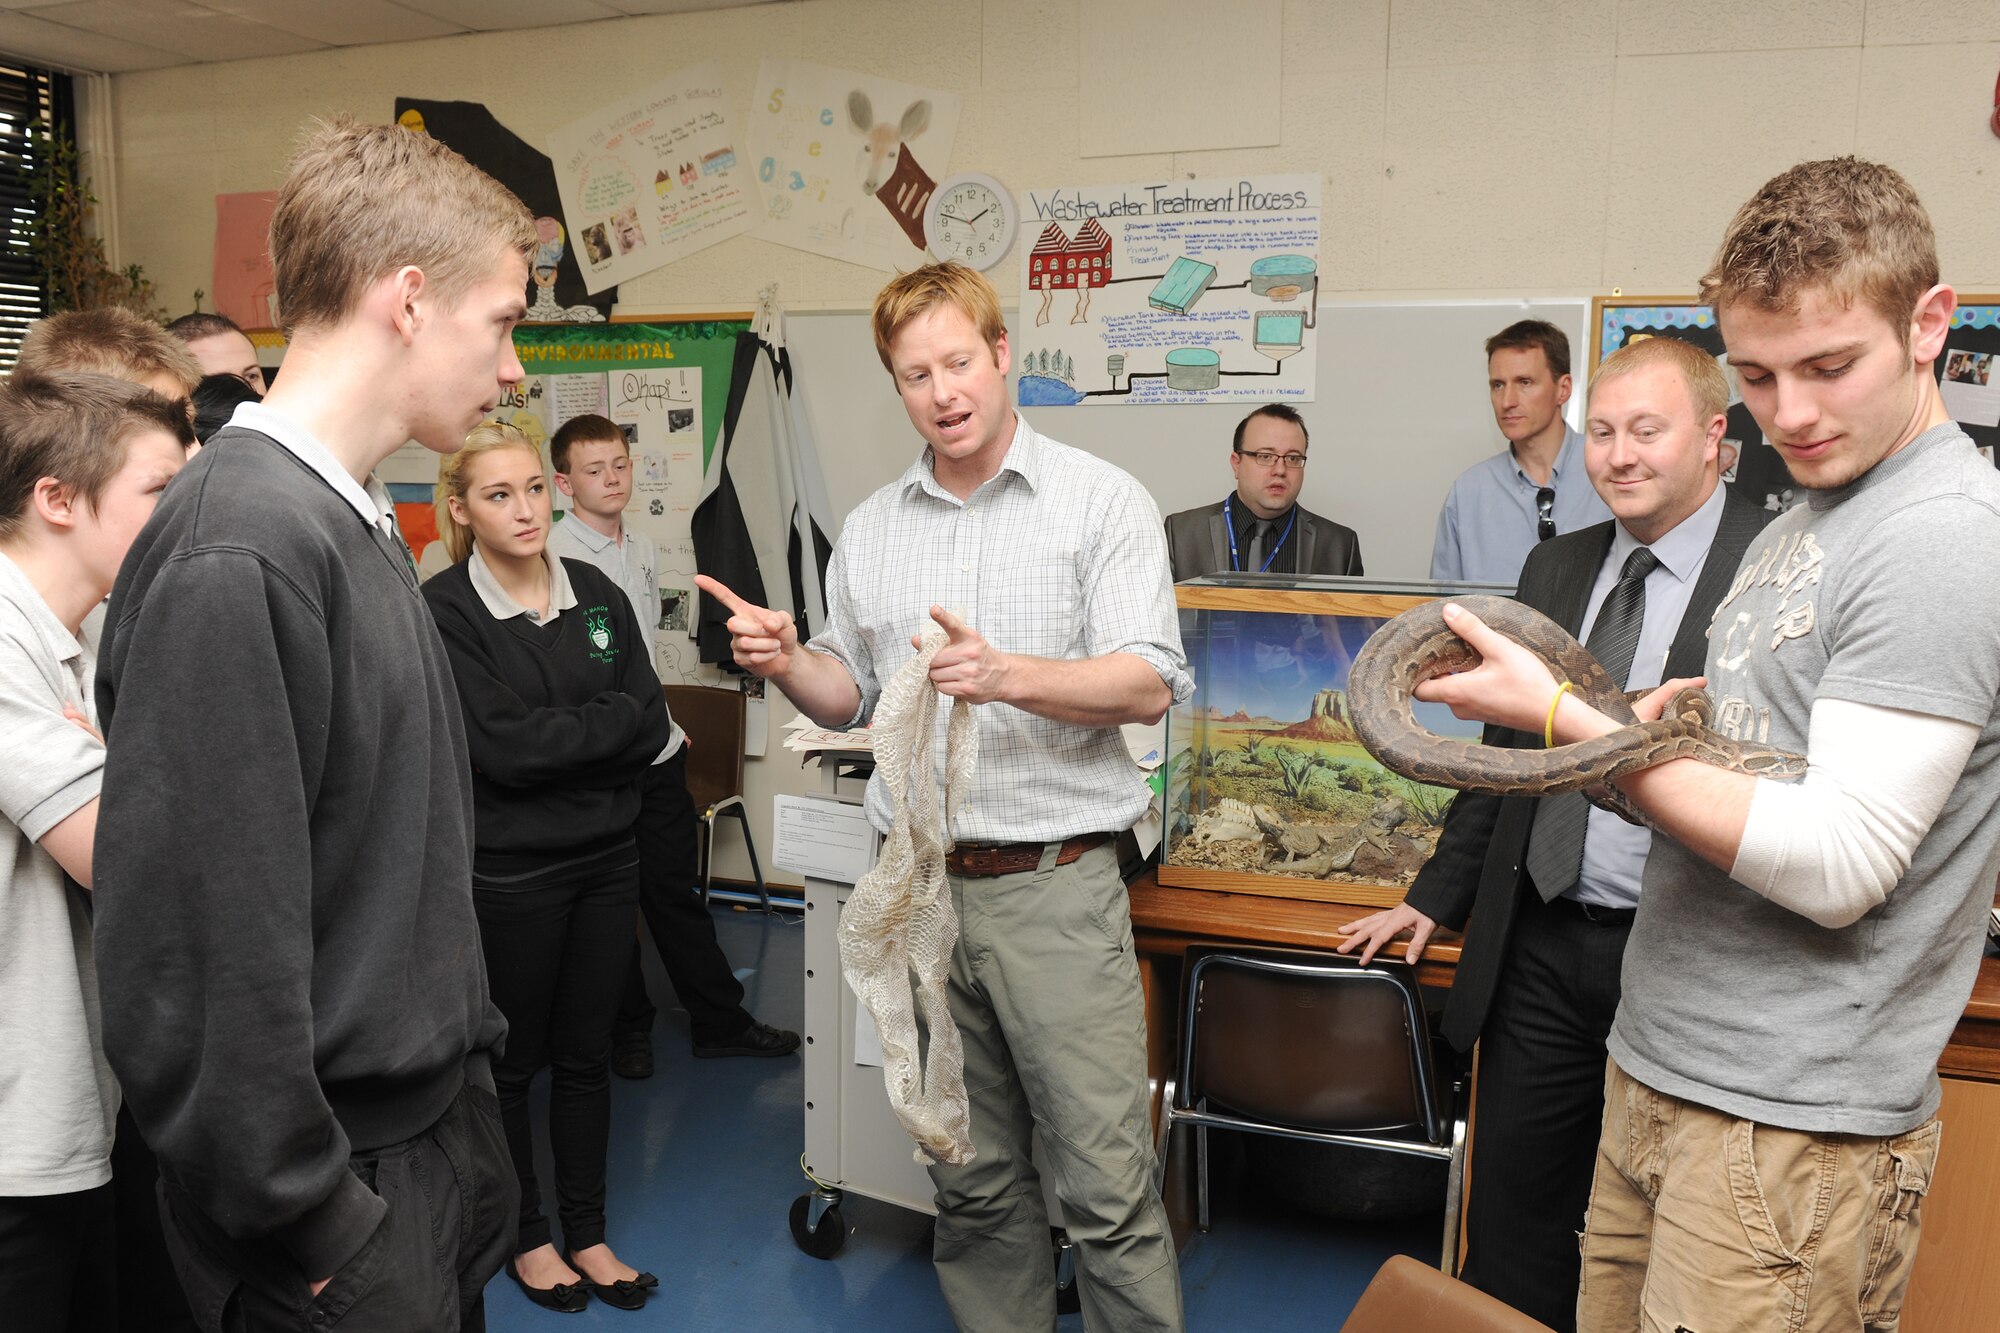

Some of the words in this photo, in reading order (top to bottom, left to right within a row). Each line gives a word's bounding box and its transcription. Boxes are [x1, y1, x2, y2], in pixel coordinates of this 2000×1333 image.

[955, 194, 962, 204] 11
[966, 189, 976, 199] 12
[1030, 189, 1147, 220] Wastewater
[1144, 184, 1233, 213] Treatment
[1239, 181, 1307, 211] Process
[945, 204, 955, 214] 10
[990, 203, 997, 213] 2
[942, 217, 948, 227] 9
[992, 218, 1000, 228] 3
[944, 232, 951, 242] 8
[988, 233, 995, 242] 4
[955, 242, 961, 252] 7
[966, 246, 973, 256] 6
[979, 242, 985, 252] 5
[1127, 246, 1158, 255] Primary
[1129, 253, 1170, 264] Treatment
[497, 393, 529, 409] LAS!
[658, 543, 672, 554] the
